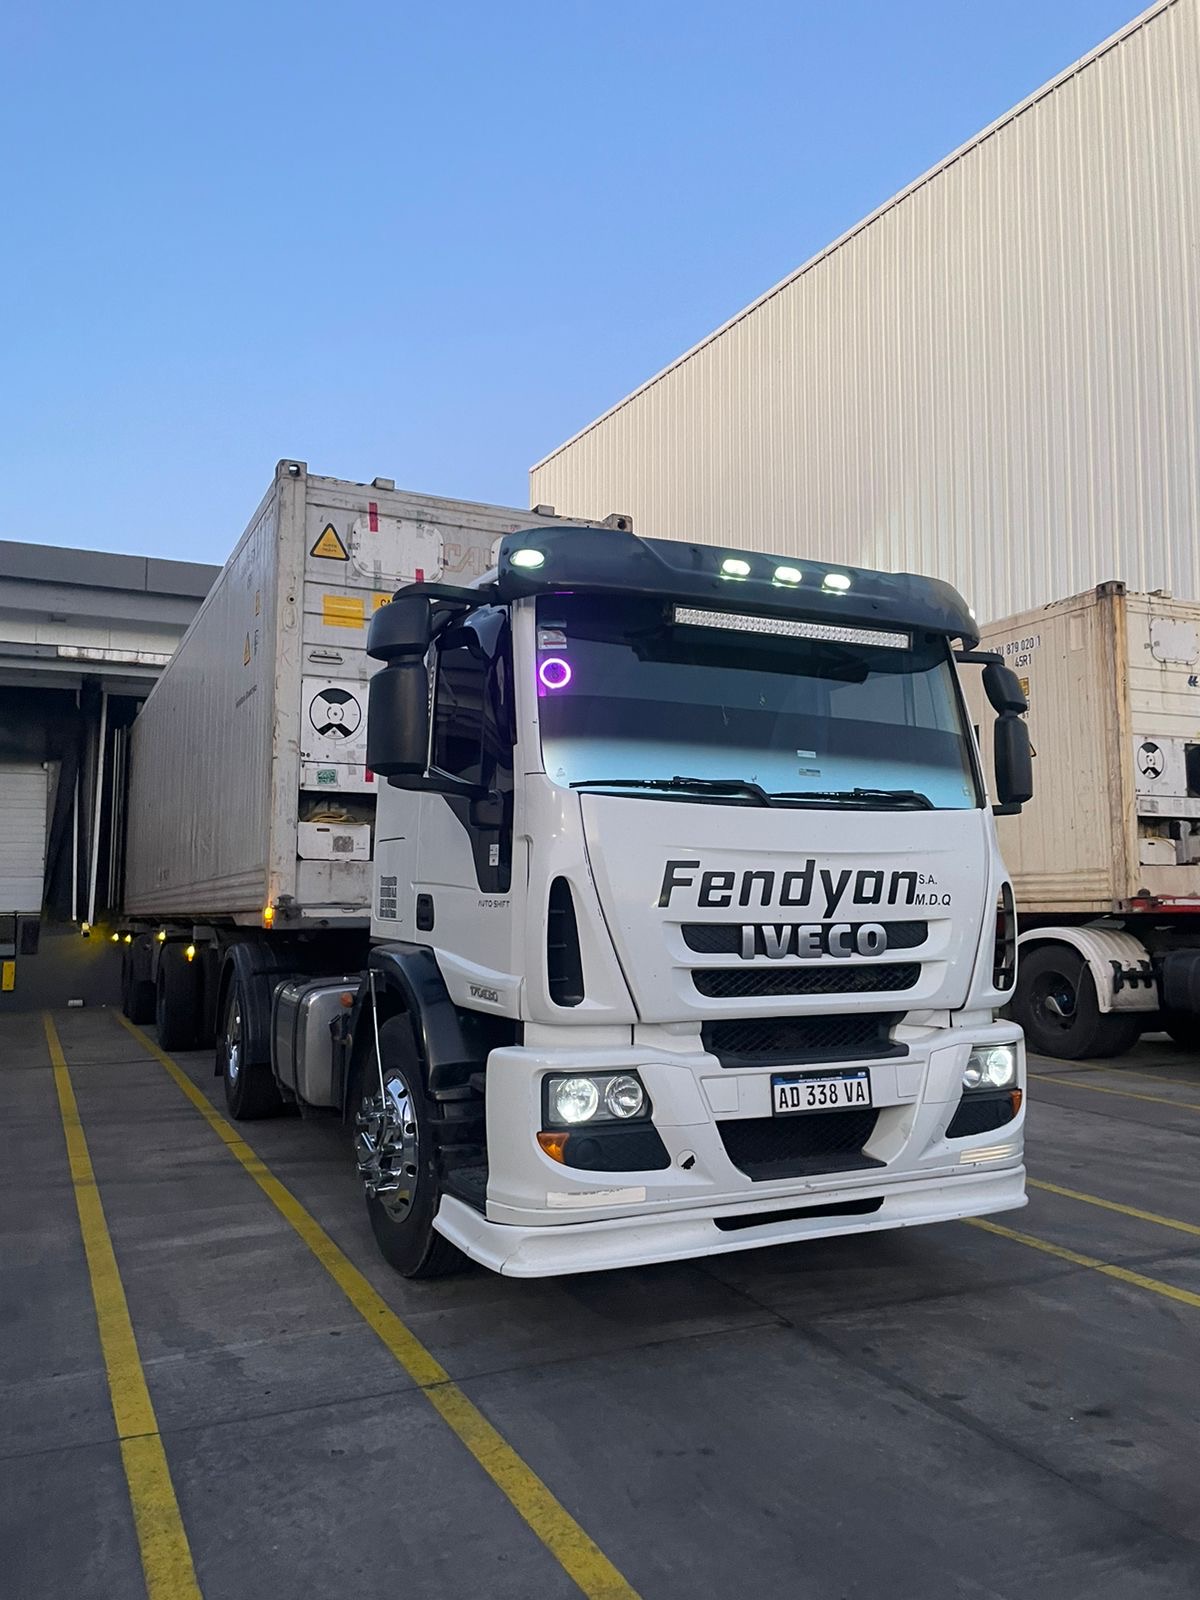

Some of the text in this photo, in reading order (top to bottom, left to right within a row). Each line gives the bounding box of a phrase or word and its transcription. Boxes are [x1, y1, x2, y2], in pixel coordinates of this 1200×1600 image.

[1006, 642, 1019, 655] 879
[1020, 638, 1034, 651] 020
[1015, 654, 1032, 667] 45R1
[917, 873, 938, 885] S.A.
[658, 859, 917, 919] Fendyan
[478, 899, 510, 908] AUTO SHIFT
[914, 893, 952, 907] M.D.Q
[739, 923, 888, 960] IVECO
[779, 1081, 865, 1109] AD 338 VA
